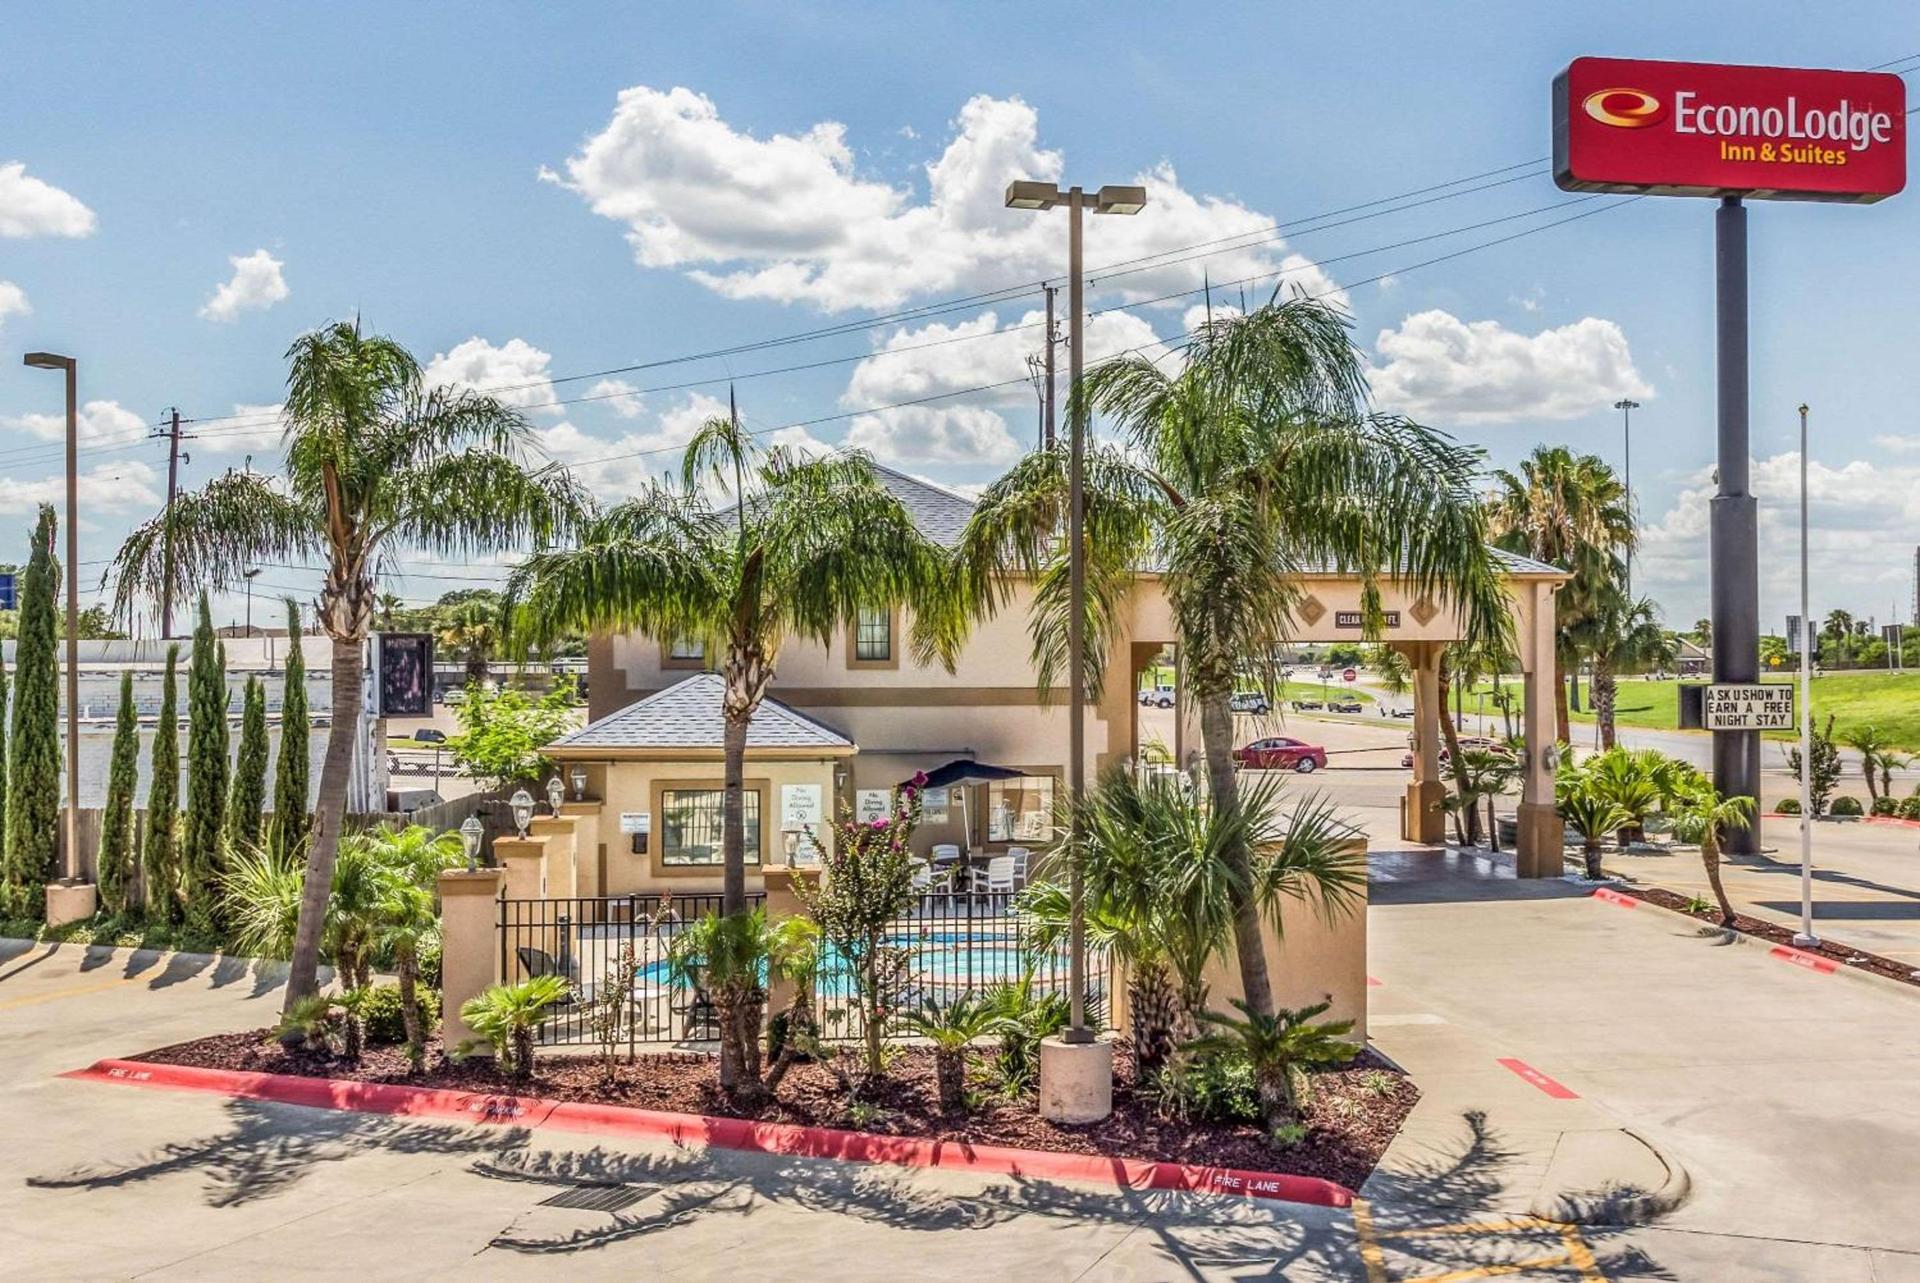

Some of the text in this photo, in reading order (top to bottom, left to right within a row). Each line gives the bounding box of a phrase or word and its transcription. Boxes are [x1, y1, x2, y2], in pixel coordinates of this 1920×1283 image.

[1720, 140, 1846, 165] Inn & Suites
[1778, 690, 1792, 701] TO
[1708, 702, 1791, 713] EARN A FREE
[1714, 714, 1786, 726] NIGHT STAY
[1213, 1175, 1281, 1193] FIRE LANE
